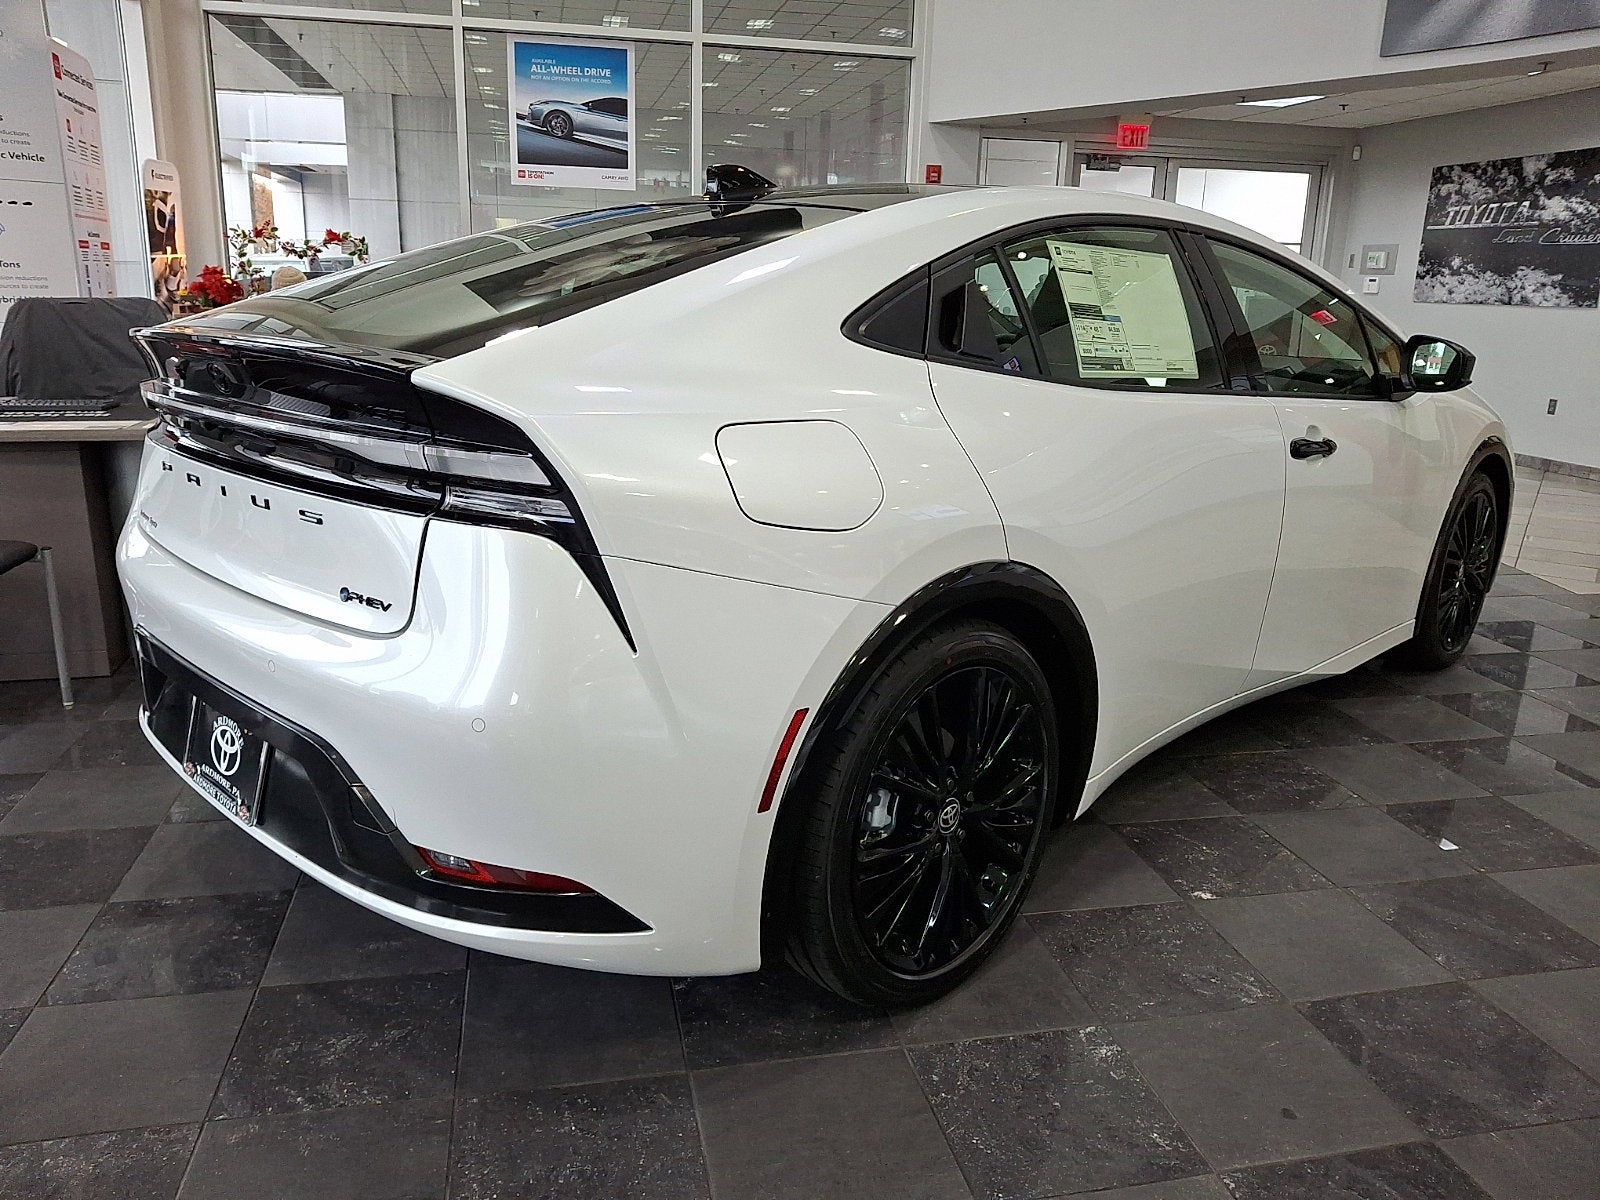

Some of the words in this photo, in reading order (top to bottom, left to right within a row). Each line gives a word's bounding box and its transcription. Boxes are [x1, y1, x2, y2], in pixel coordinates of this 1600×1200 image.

[531, 64, 582, 76] ALL-WHEEL
[584, 67, 611, 77] DRIVE
[1122, 125, 1147, 147] EXIT
[8, 150, 46, 162] Vehicle
[1444, 200, 1531, 227] TOYOTA
[1491, 228, 1538, 244] Land
[0, 260, 22, 268] Tons
[162, 460, 324, 526] PRIUS
[349, 591, 393, 612] PHEV
[213, 715, 245, 750] ARDMORE
[201, 763, 232, 793] ARDMORE,
[193, 773, 217, 799] ARDMORE
[216, 790, 237, 815] TOYOTA
